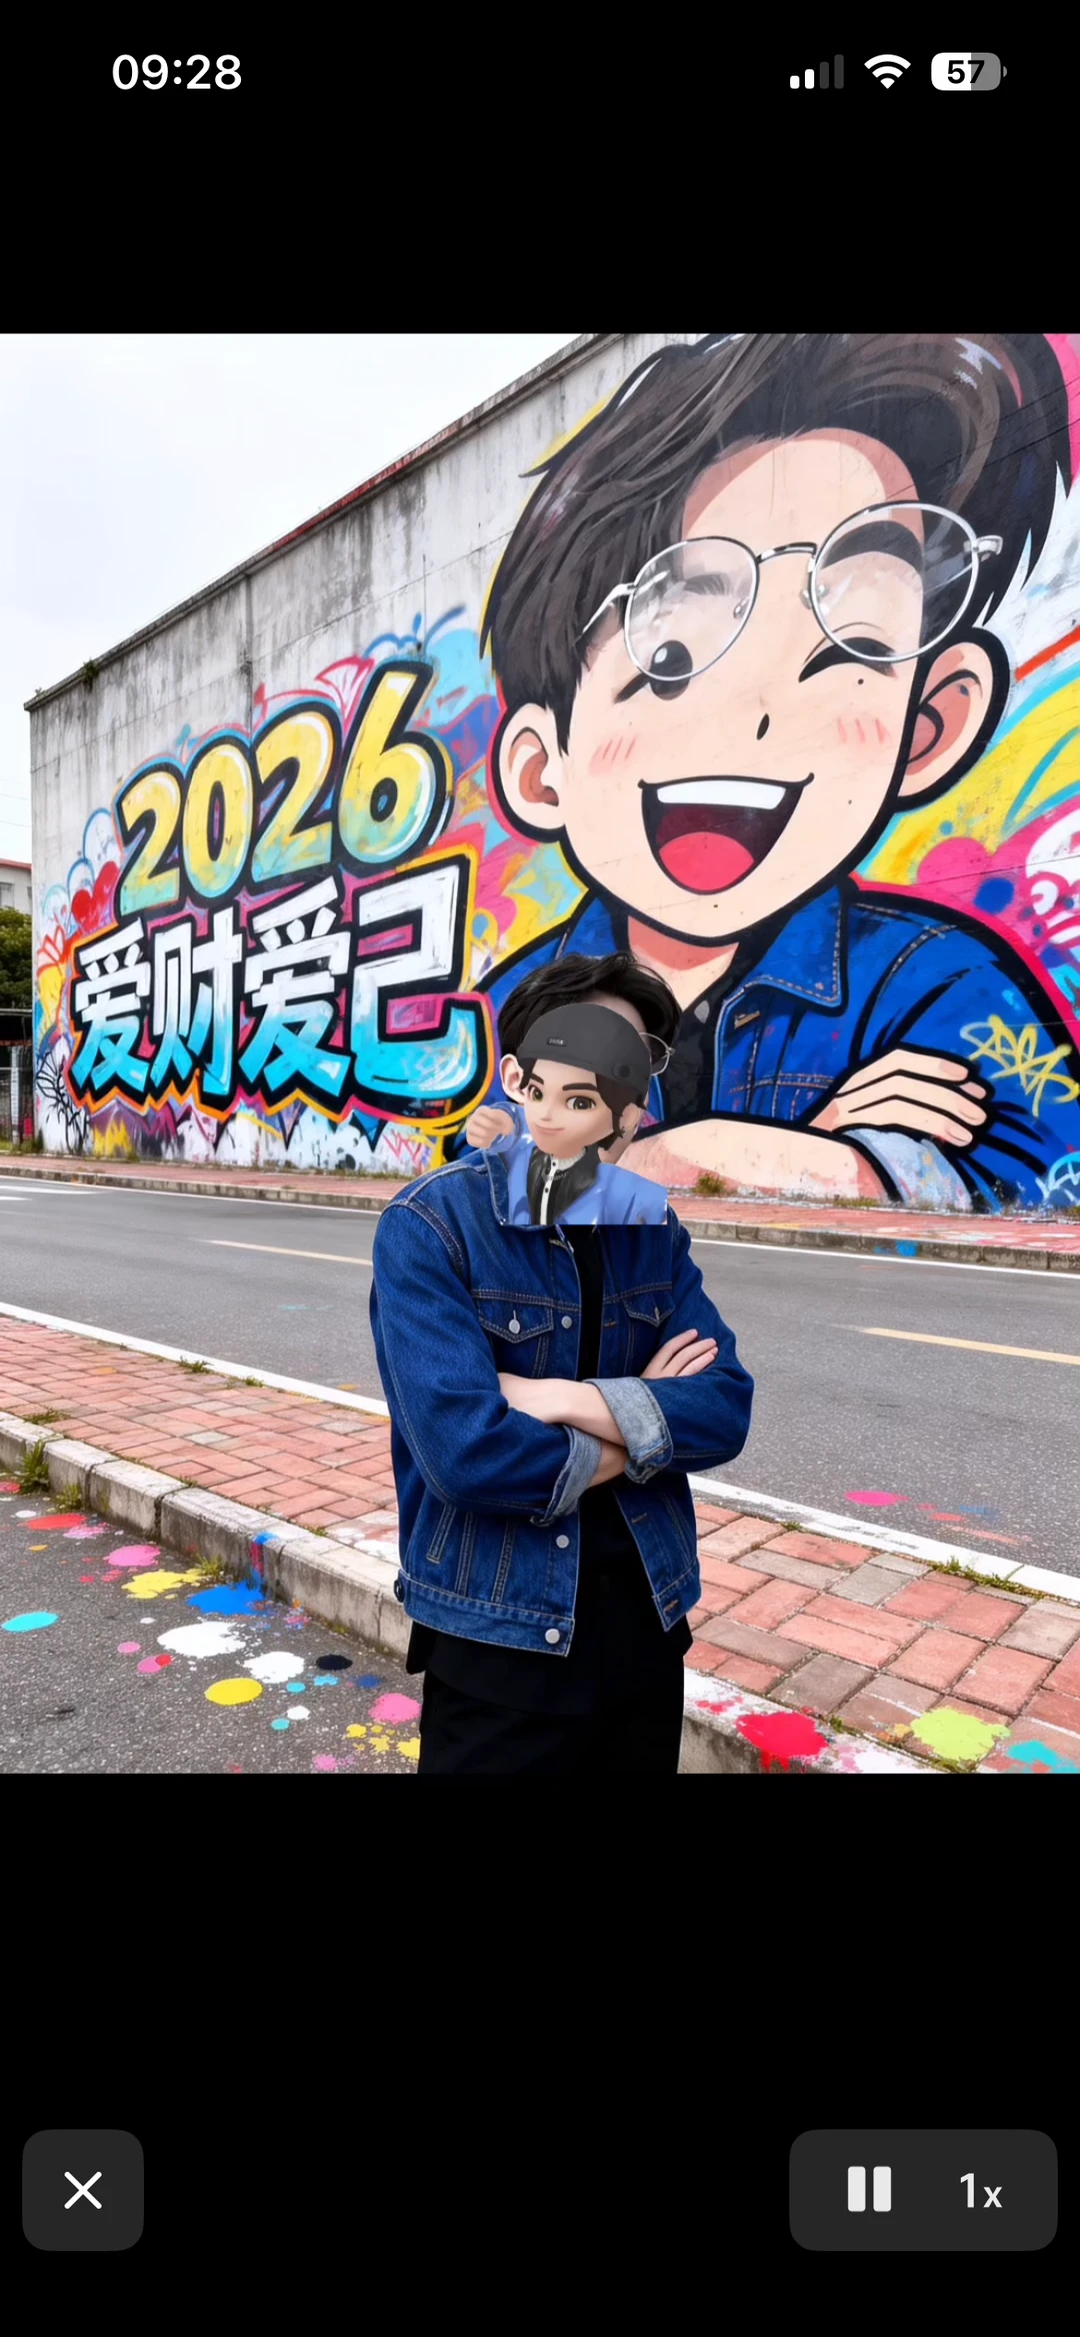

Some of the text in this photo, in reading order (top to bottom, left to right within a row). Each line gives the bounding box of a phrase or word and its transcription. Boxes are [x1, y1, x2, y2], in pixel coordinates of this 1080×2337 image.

[118, 669, 438, 917] 2026
[71, 863, 479, 1098] 爱财爱己
